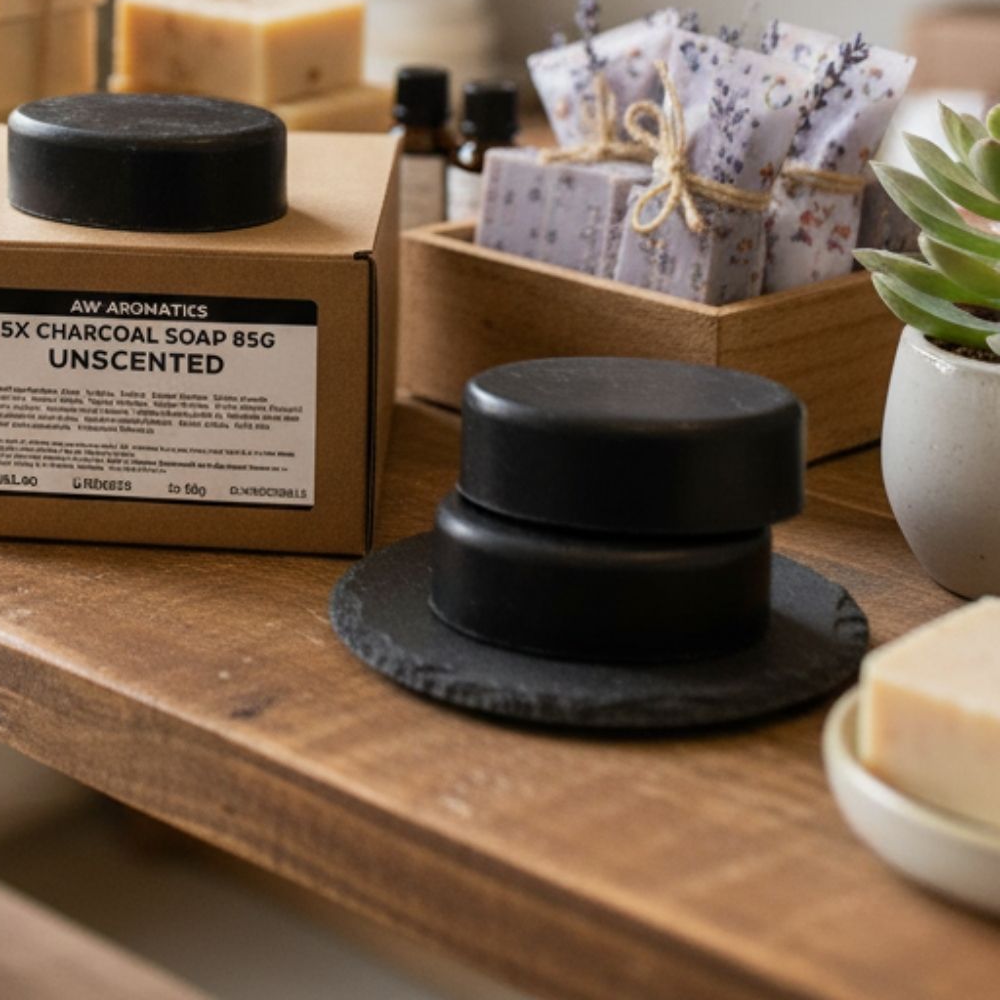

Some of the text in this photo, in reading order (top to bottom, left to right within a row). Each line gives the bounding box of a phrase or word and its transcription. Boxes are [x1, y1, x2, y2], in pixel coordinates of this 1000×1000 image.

[70, 300, 100, 314] AW
[1, 322, 276, 349] 5X CHARCOAL SOAP 85G
[48, 349, 224, 375] UNSCENTED
